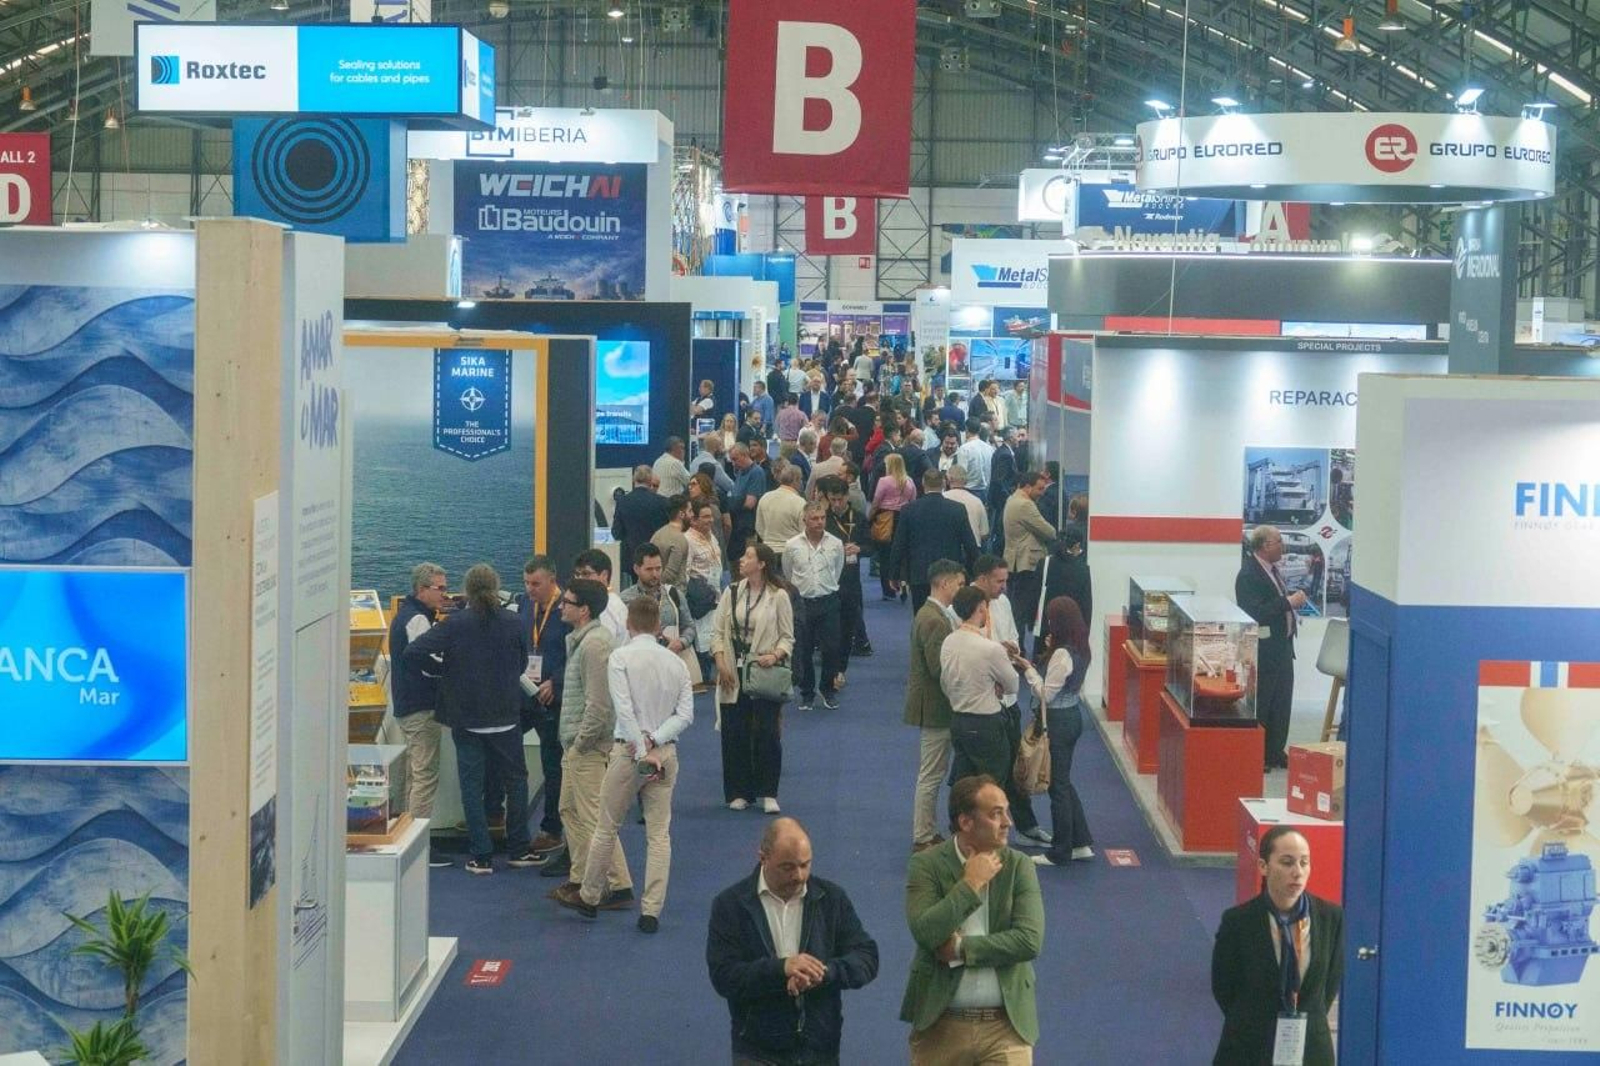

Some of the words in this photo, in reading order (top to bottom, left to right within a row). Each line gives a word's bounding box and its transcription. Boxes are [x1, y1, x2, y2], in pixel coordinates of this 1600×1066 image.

[186, 61, 266, 81] Roxtec
[339, 60, 375, 71] Sealing
[377, 60, 421, 70] solutions
[330, 73, 345, 83] for
[347, 73, 378, 83] cables
[380, 73, 400, 83] and
[402, 74, 430, 85] pipes
[772, 20, 863, 156] B
[27, 150, 36, 163] 2
[1194, 142, 1283, 158] EURORED
[1429, 142, 1497, 157] GRUPO
[479, 173, 622, 199] WEICHAI
[0, 173, 32, 223] D
[523, 208, 562, 216] MOTEURS
[823, 195, 858, 239] B
[502, 208, 621, 232] Baudouin
[1297, 341, 1334, 351] SPECIAL
[1336, 343, 1382, 352] PROJECTS
[460, 356, 486, 367] SIKA
[452, 367, 494, 378] MARINE
[1269, 390, 1357, 406] REPARAC
[443, 428, 501, 437] PROFESSIONAL'S
[465, 421, 479, 429] THE
[460, 436, 485, 444] CHOICE
[1515, 482, 1600, 517] FIN
[0, 647, 120, 683] ANCA
[79, 687, 120, 705] Mar
